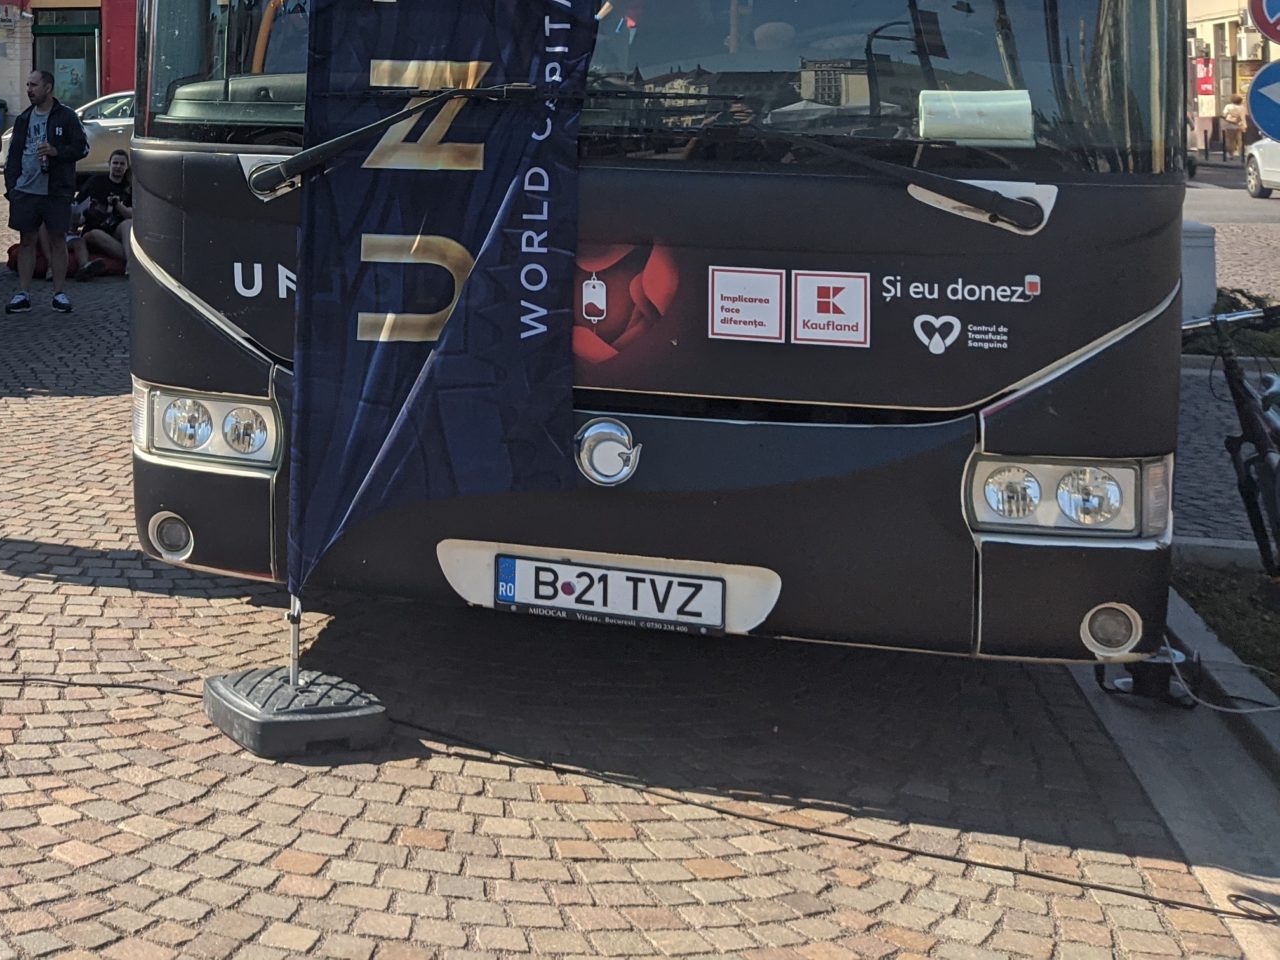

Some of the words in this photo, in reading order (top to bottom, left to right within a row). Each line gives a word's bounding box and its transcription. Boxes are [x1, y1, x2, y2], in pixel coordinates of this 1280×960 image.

[520, 166, 550, 339] WORLD
[881, 275, 902, 302] Și
[909, 282, 939, 299] eu
[946, 277, 1025, 303] donez
[720, 293, 770, 305] Implicarea
[720, 305, 741, 314] face
[802, 319, 859, 332] Kaufland
[967, 324, 996, 332] Centrul
[997, 325, 1008, 333] de
[967, 332, 1008, 341] Transfuzie
[498, 581, 515, 597] RO
[625, 576, 704, 619] TVZ
[528, 606, 568, 618] MIDOCAR
